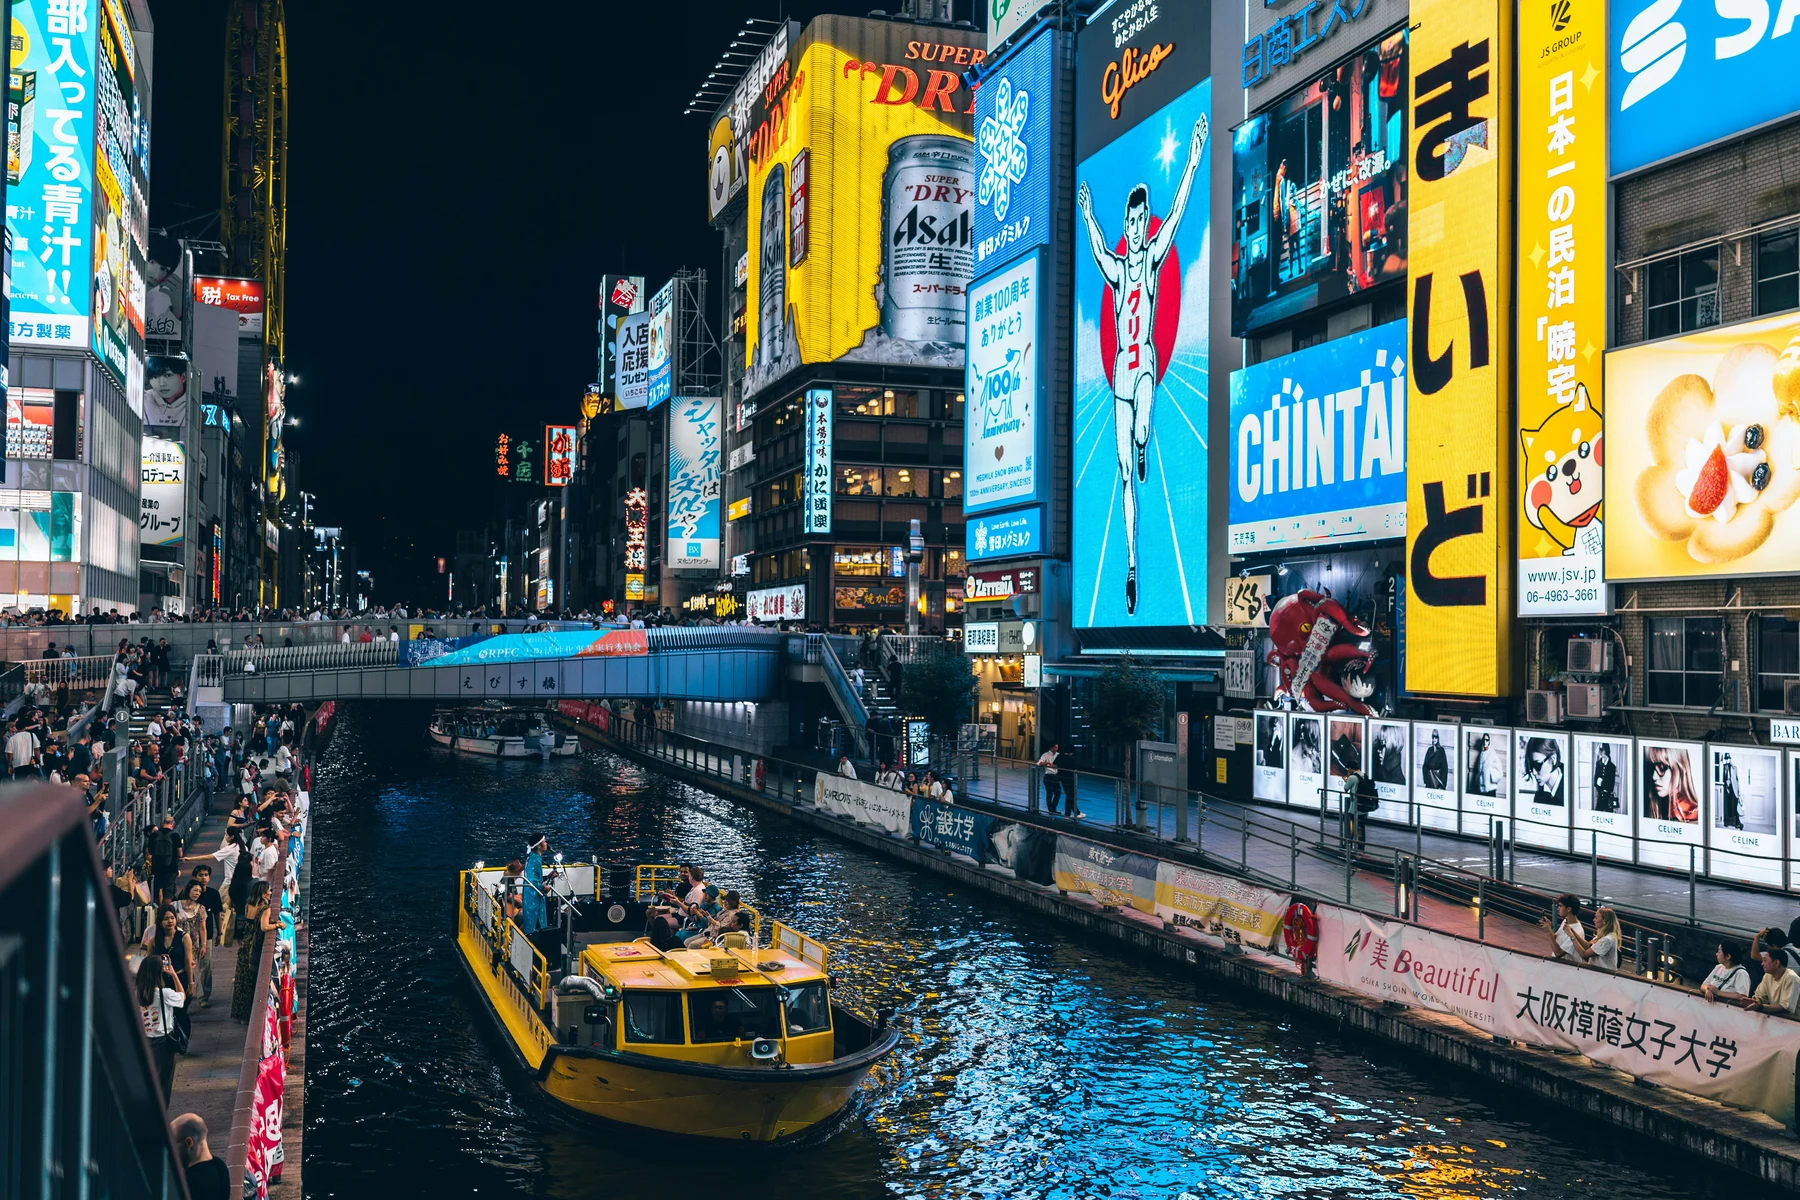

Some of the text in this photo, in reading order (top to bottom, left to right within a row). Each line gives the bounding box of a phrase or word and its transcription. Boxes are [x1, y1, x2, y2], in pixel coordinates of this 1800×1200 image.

[1115, 5, 1159, 48] ゆたかな人生
[905, 40, 988, 67] SUPER
[1241, 0, 1366, 90] 日商エス
[1541, 31, 1582, 59] JS GROUP
[765, 59, 790, 111] SUPER
[1101, 43, 1173, 120] Glico
[925, 174, 959, 185] SUPER
[1547, 70, 1576, 309] 日本一の民泊
[893, 204, 975, 250] Asah
[978, 215, 1031, 262] 雪印メグミルク
[929, 252, 953, 271] 生
[10, 291, 39, 300] acteria
[202, 286, 221, 305] 税
[226, 293, 259, 302] Tax Free
[974, 276, 1030, 323] 創業100周年
[981, 311, 1022, 348] ありがとう
[1127, 282, 1141, 371] グリコ
[1410, 37, 1491, 607] まいど
[622, 322, 649, 349] 入店
[622, 347, 649, 373] 応援
[621, 371, 649, 386] プレゼン
[1238, 362, 1405, 503] CHINTAI
[142, 468, 180, 483] ロデュース
[1007, 464, 1023, 475] BRAND
[688, 545, 699, 554] BX
[989, 530, 1031, 552] 雪印メグミルク
[1528, 566, 1596, 585] www.jsv.jp
[1526, 588, 1597, 603] 06-4963-3661
[463, 676, 556, 690] えびす橋
[1380, 785, 1397, 794] CELINE
[1426, 792, 1444, 801] CELINE
[1476, 799, 1495, 808] CELINE
[1530, 807, 1552, 817] CELINE
[1591, 815, 1614, 825] CELINE
[1657, 824, 1683, 835] CELINE
[1731, 835, 1759, 846] CELINE
[1369, 937, 1500, 1003] 美 Beautiful
[1383, 982, 1407, 995] SHOIN
[1451, 1003, 1496, 1024] UNIVERSITY
[1516, 985, 1738, 1078] 大阪樟蔭女子大学
